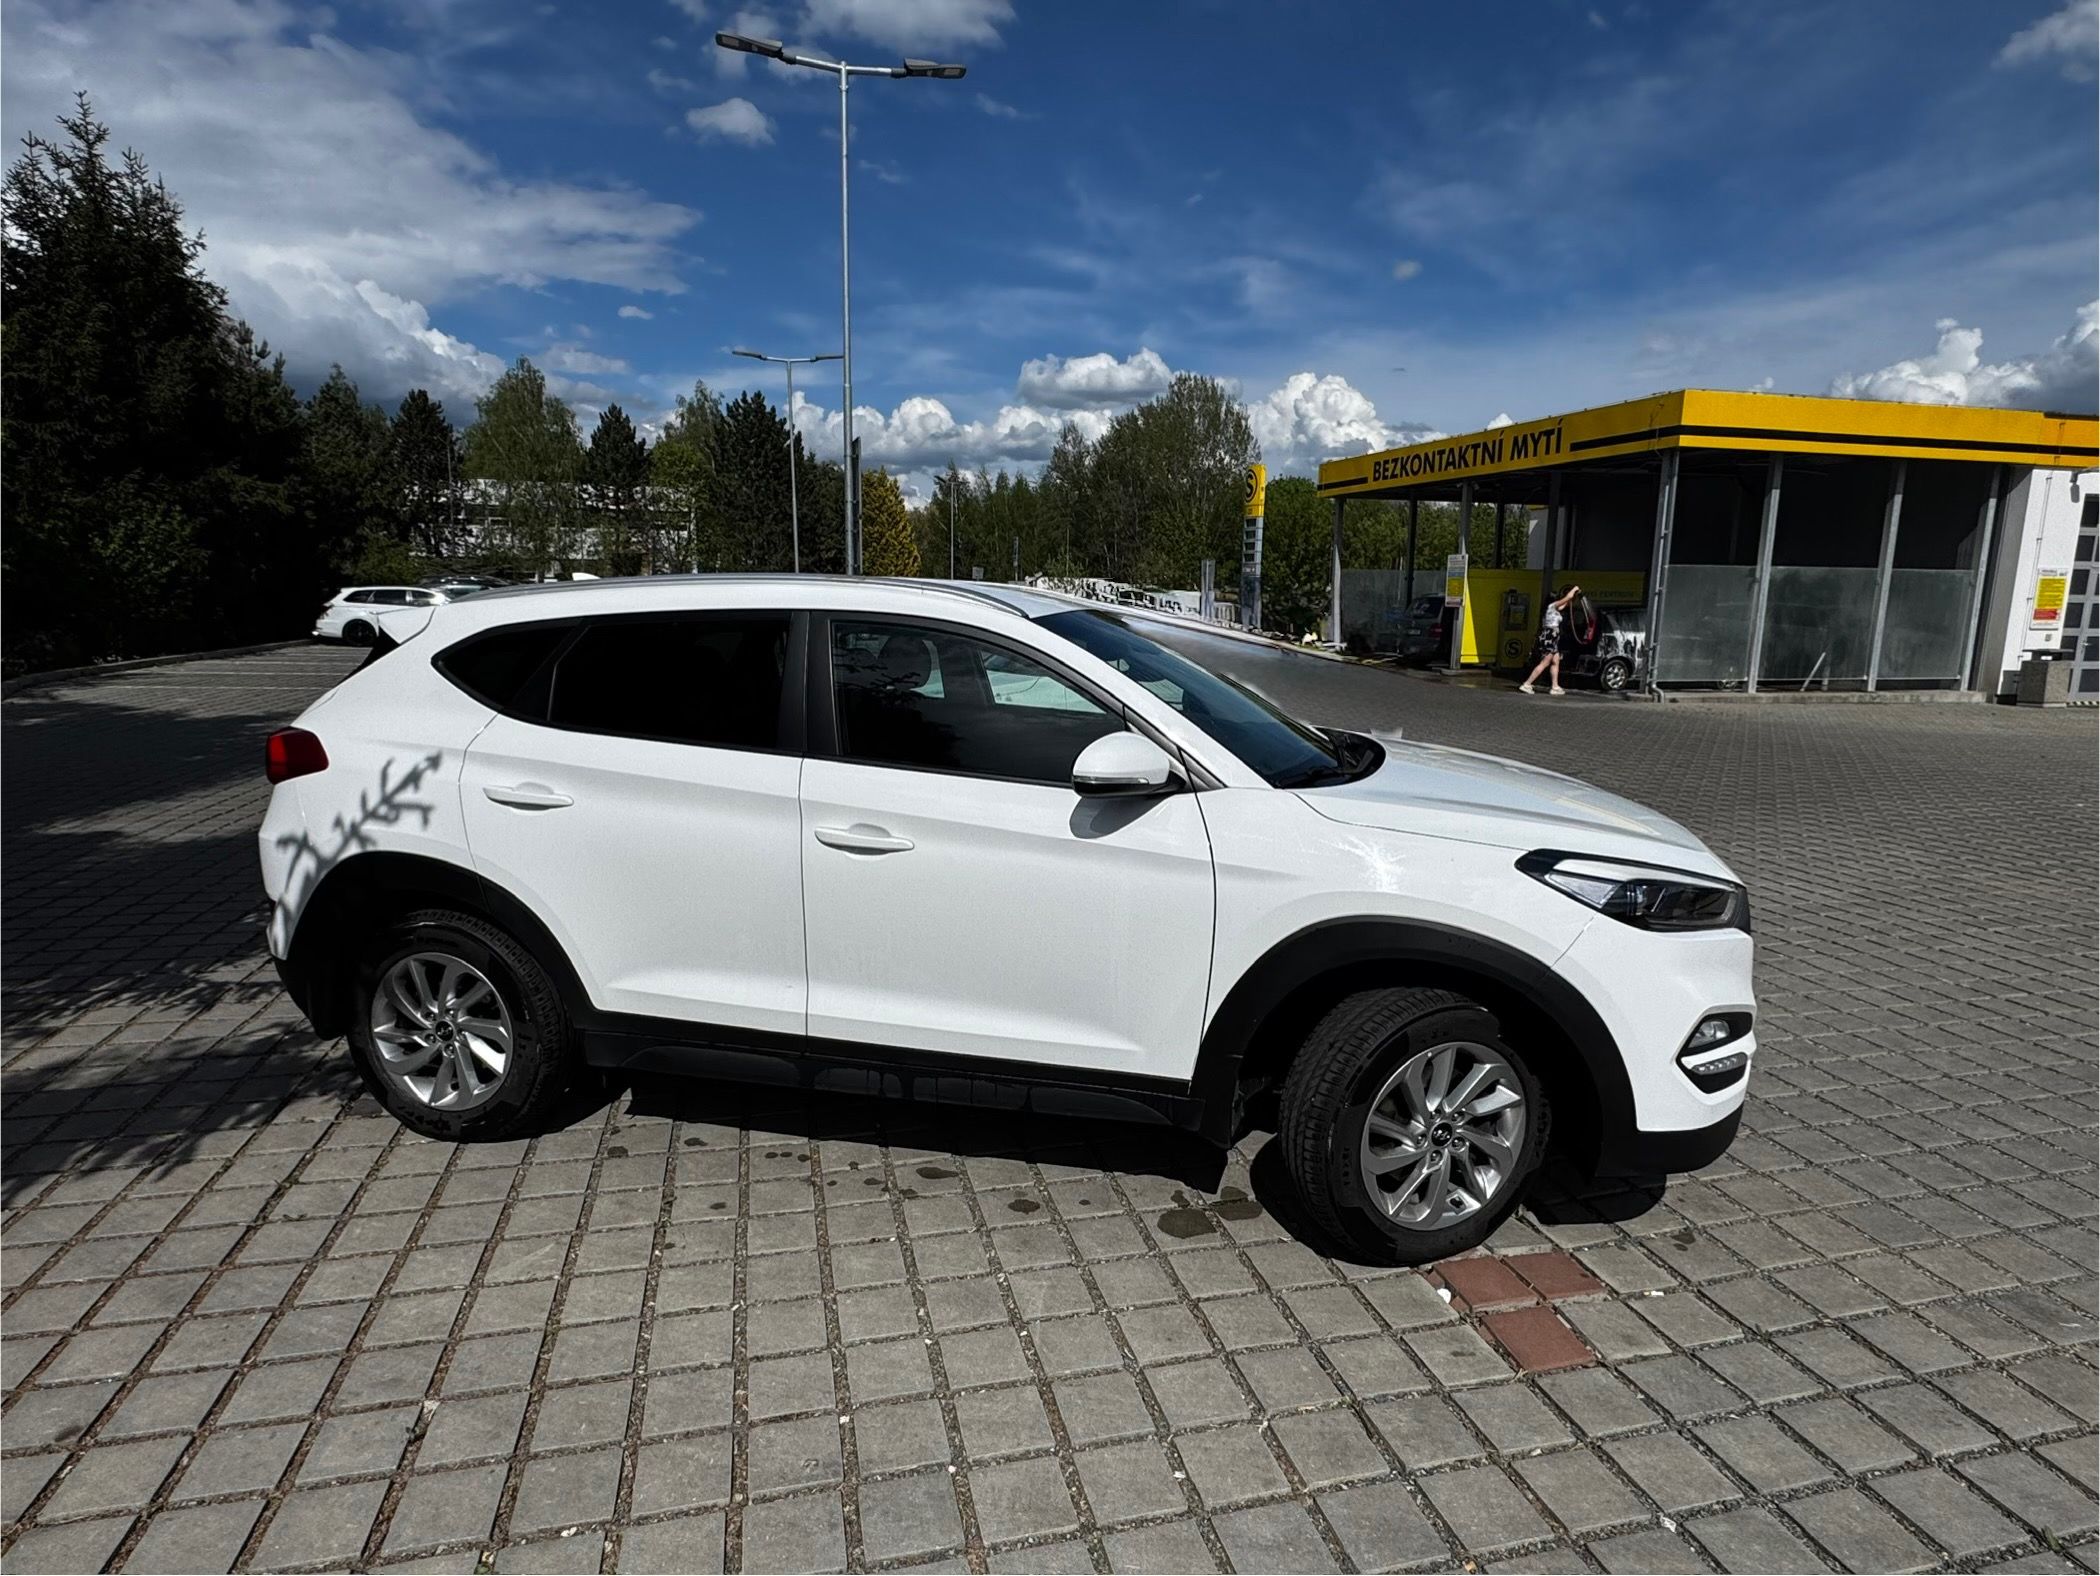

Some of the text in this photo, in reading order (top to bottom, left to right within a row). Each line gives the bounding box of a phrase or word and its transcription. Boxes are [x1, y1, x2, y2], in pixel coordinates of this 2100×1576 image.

[1373, 418, 1563, 482] BEZKONTAKTNÍ MYTÍ
[1508, 641, 1519, 656] S
